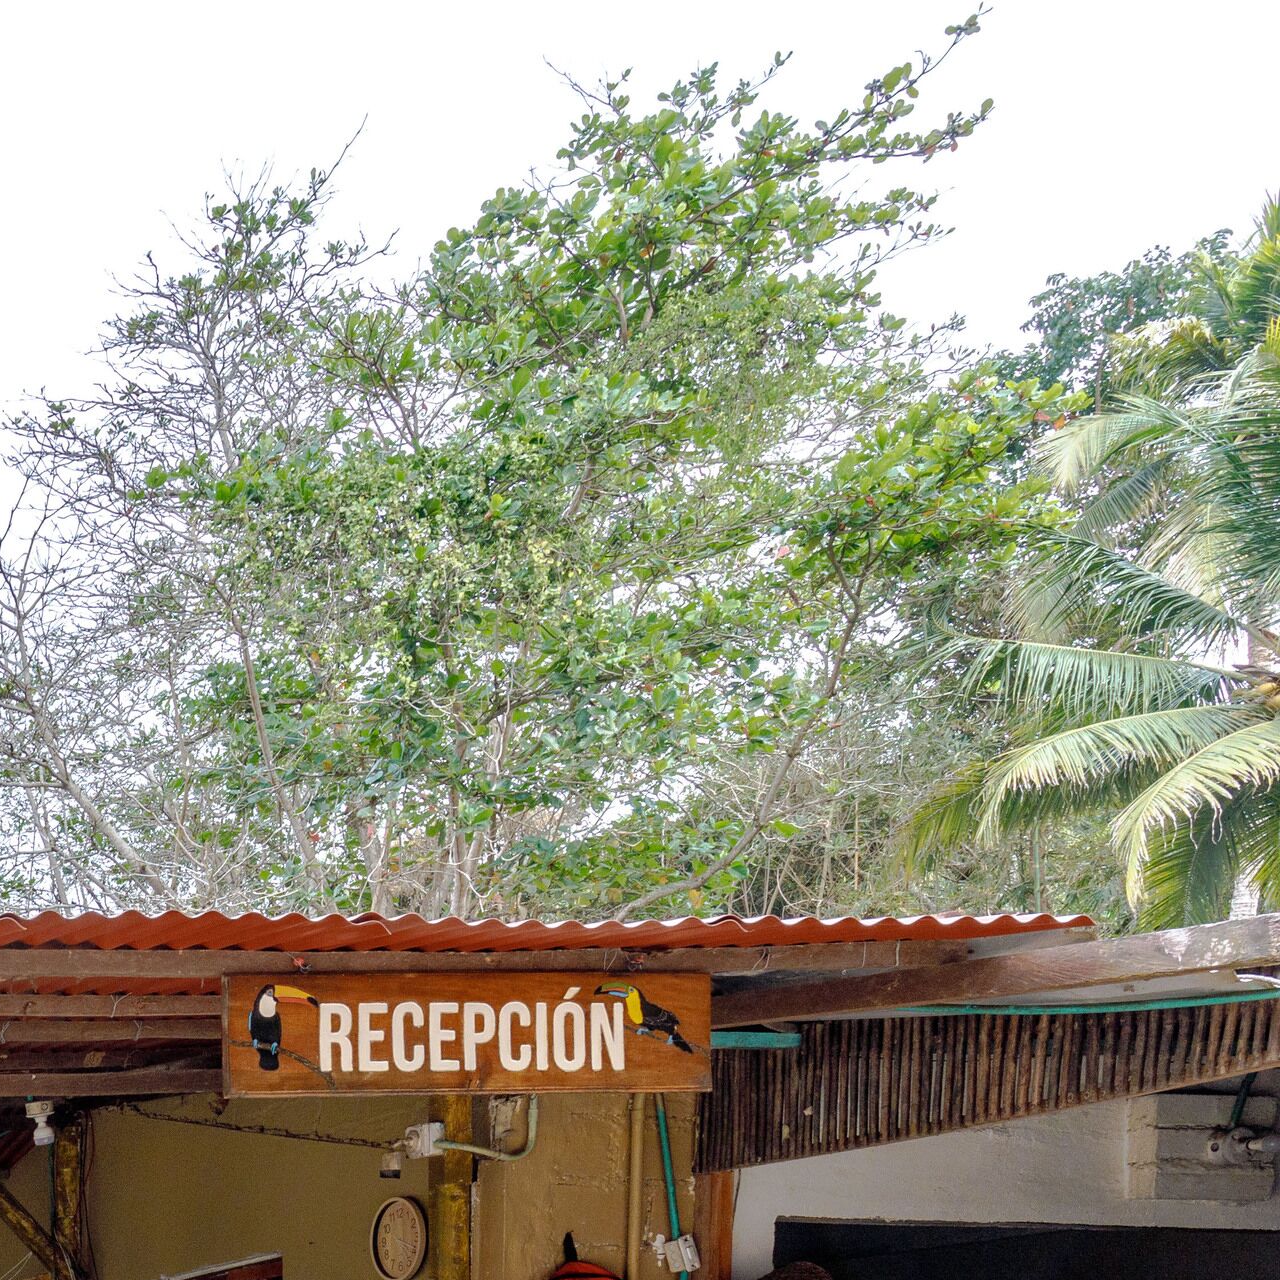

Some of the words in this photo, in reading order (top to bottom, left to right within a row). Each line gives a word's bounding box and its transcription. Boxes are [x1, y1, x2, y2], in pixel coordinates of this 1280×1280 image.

[319, 987, 625, 1072] RECEPCIÓN
[396, 1207, 403, 1218] 12
[384, 1223, 391, 1234] 10
